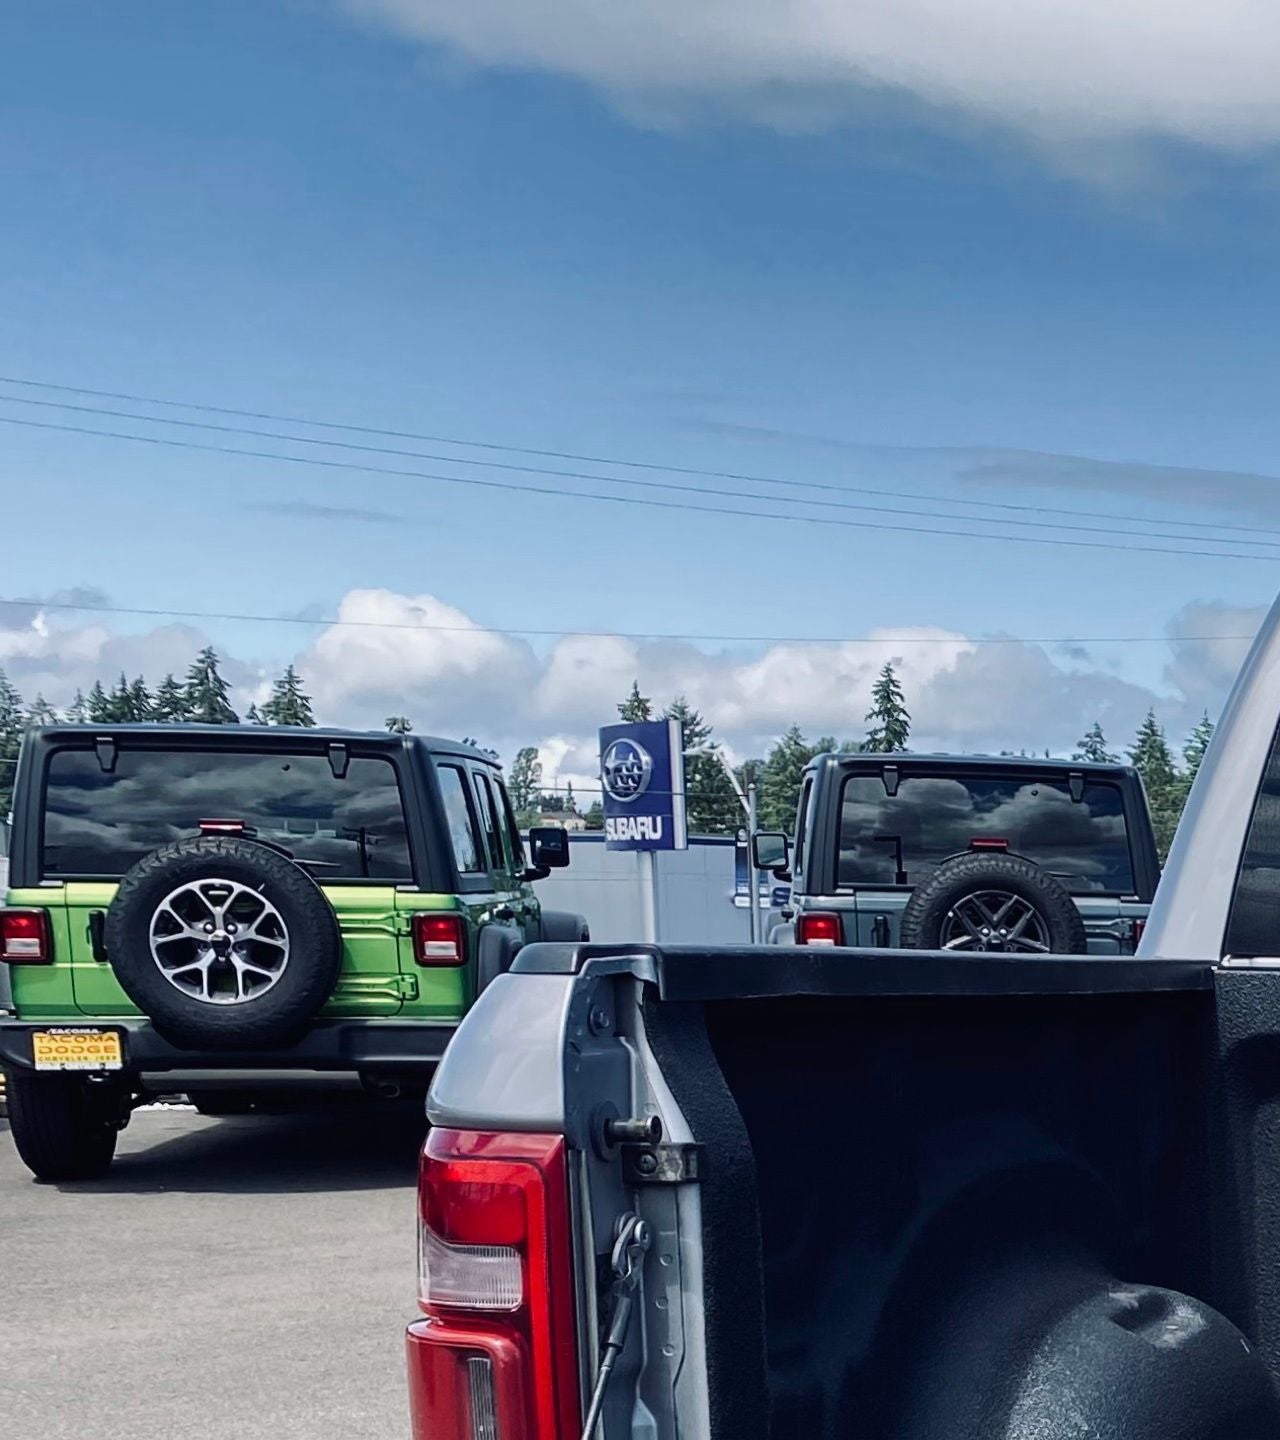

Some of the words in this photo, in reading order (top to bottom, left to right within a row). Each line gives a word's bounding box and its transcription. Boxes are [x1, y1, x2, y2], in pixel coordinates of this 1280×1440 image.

[605, 816, 662, 841] SUBARU
[35, 1035, 116, 1043] TACOMA
[38, 1045, 116, 1054] DODGE
